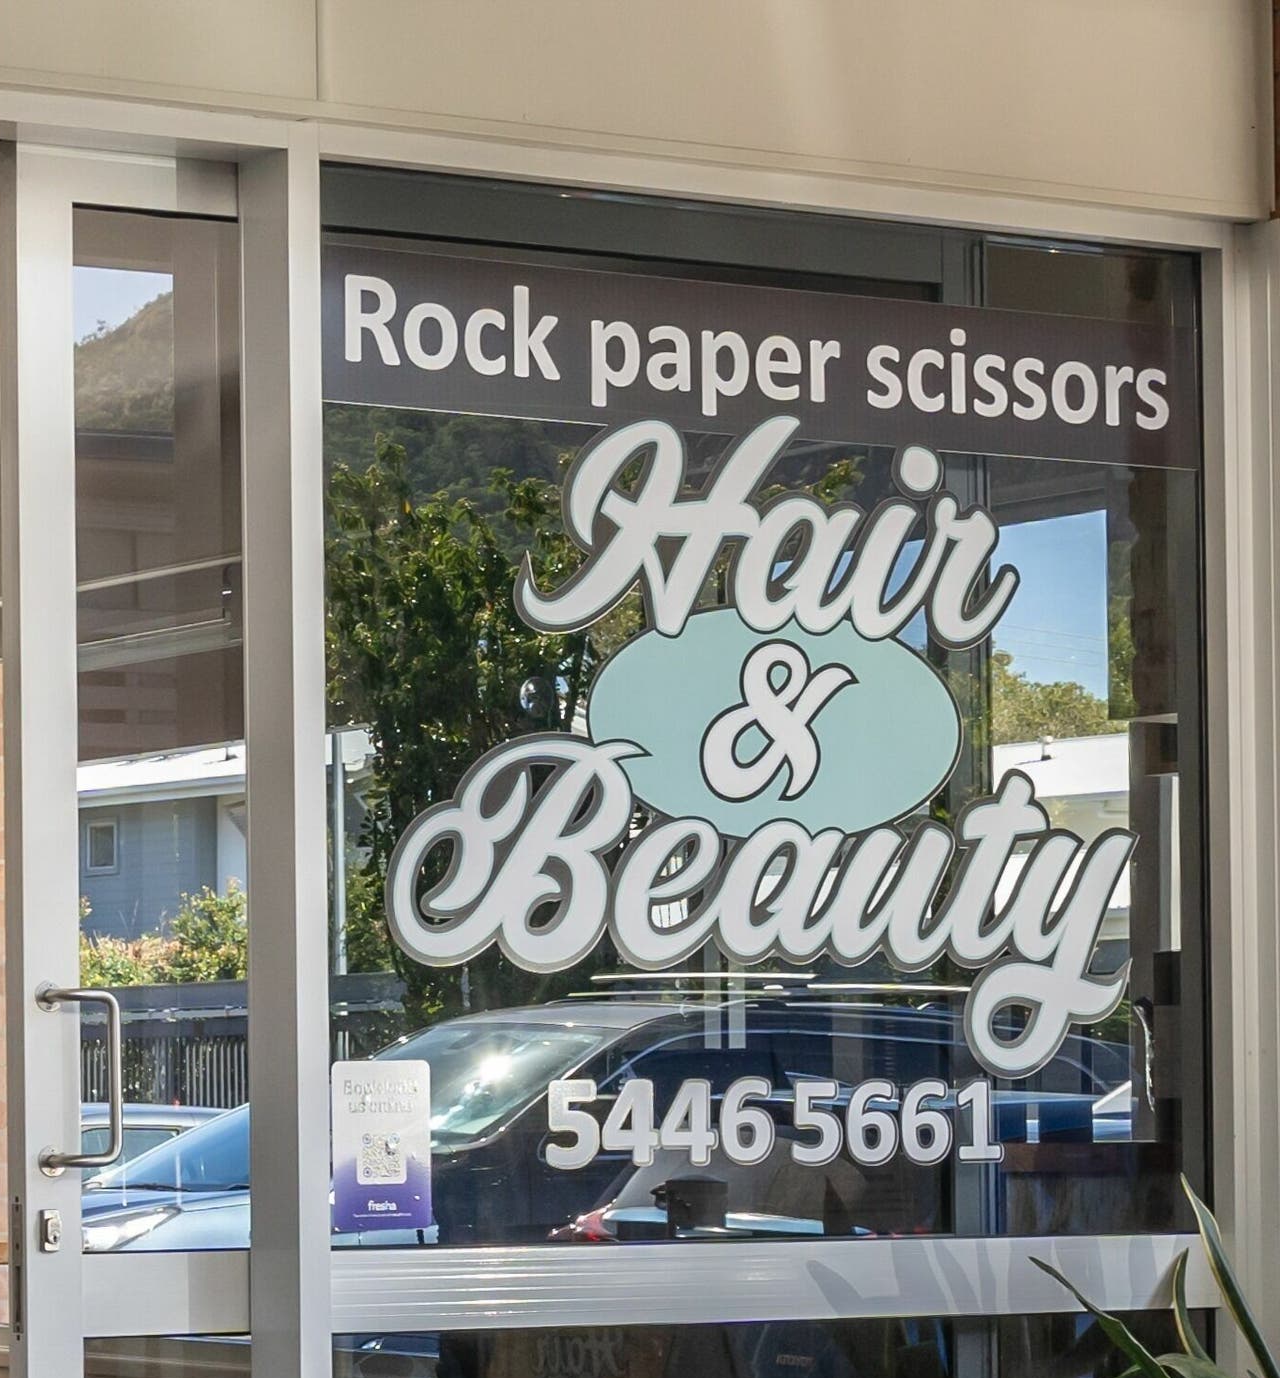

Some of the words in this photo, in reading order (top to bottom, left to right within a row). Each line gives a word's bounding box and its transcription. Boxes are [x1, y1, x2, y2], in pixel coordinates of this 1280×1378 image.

[343, 273, 561, 381] Rock
[589, 319, 841, 416] paper
[866, 328, 1171, 430] scissors
[516, 415, 1018, 648] Hair
[699, 637, 859, 803] &
[385, 732, 1140, 1078] Beauty
[545, 1076, 775, 1171] 5446
[792, 1076, 1005, 1168] 5661
[368, 1200, 397, 1211] fresha
